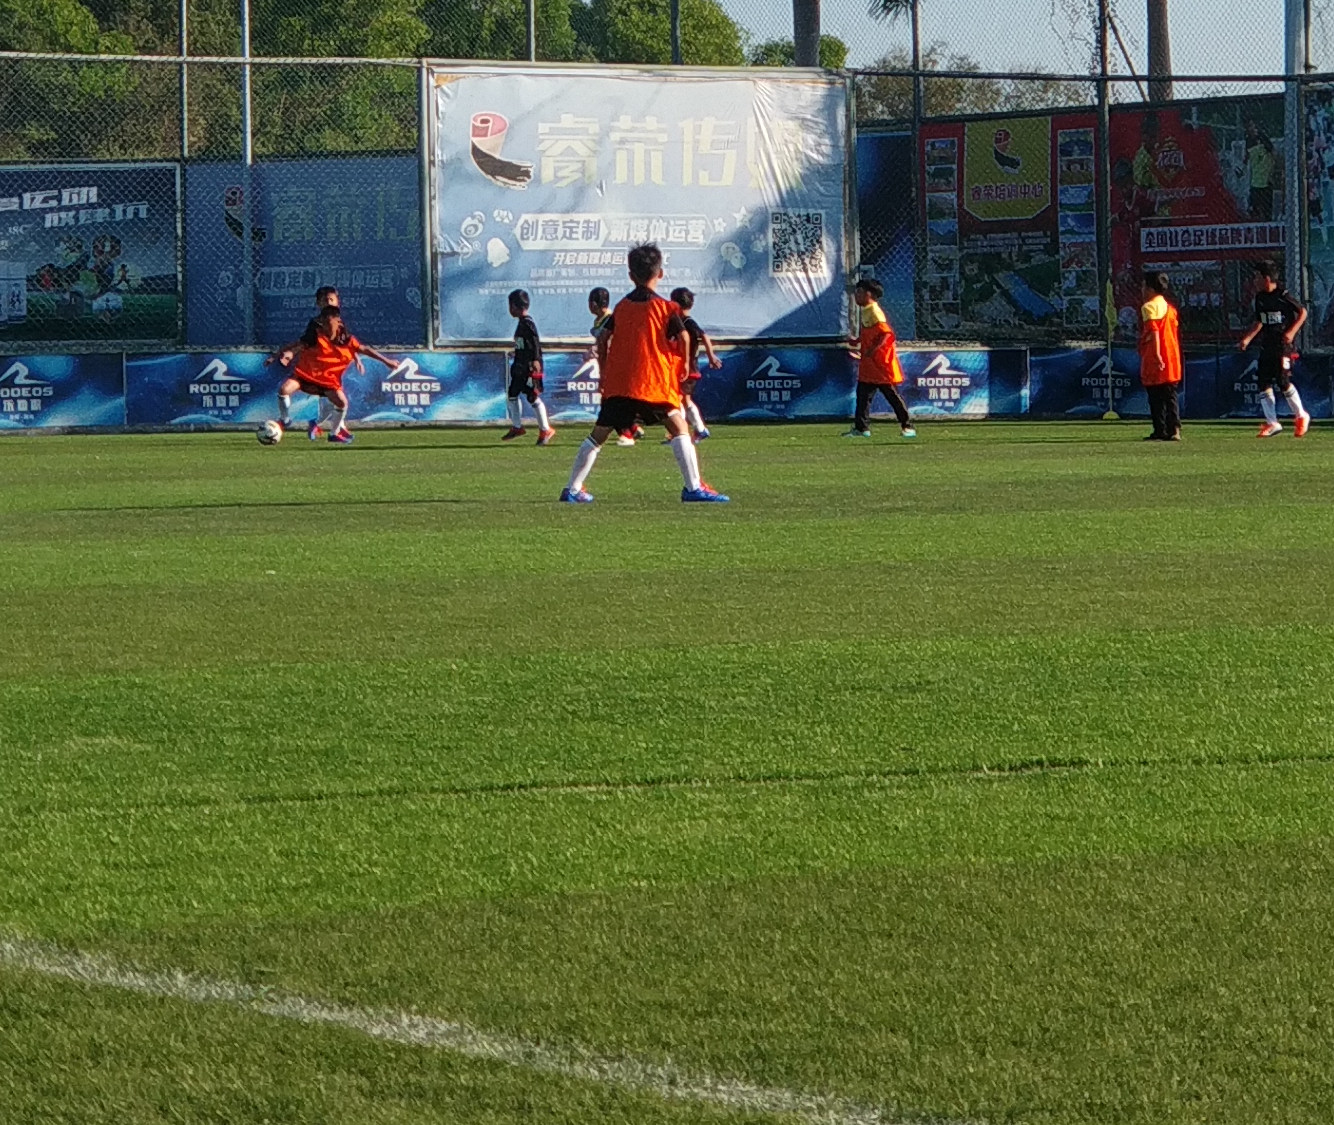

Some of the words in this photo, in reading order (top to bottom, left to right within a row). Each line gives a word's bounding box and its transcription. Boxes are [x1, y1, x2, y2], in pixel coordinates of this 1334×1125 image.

[519, 218, 601, 242] 创意定制
[609, 218, 707, 242] 新媒体运营
[381, 382, 441, 393] RODEOS
[746, 379, 802, 389] RODEOS
[917, 377, 971, 387] RODEOS
[189, 383, 251, 394] RODEOS
